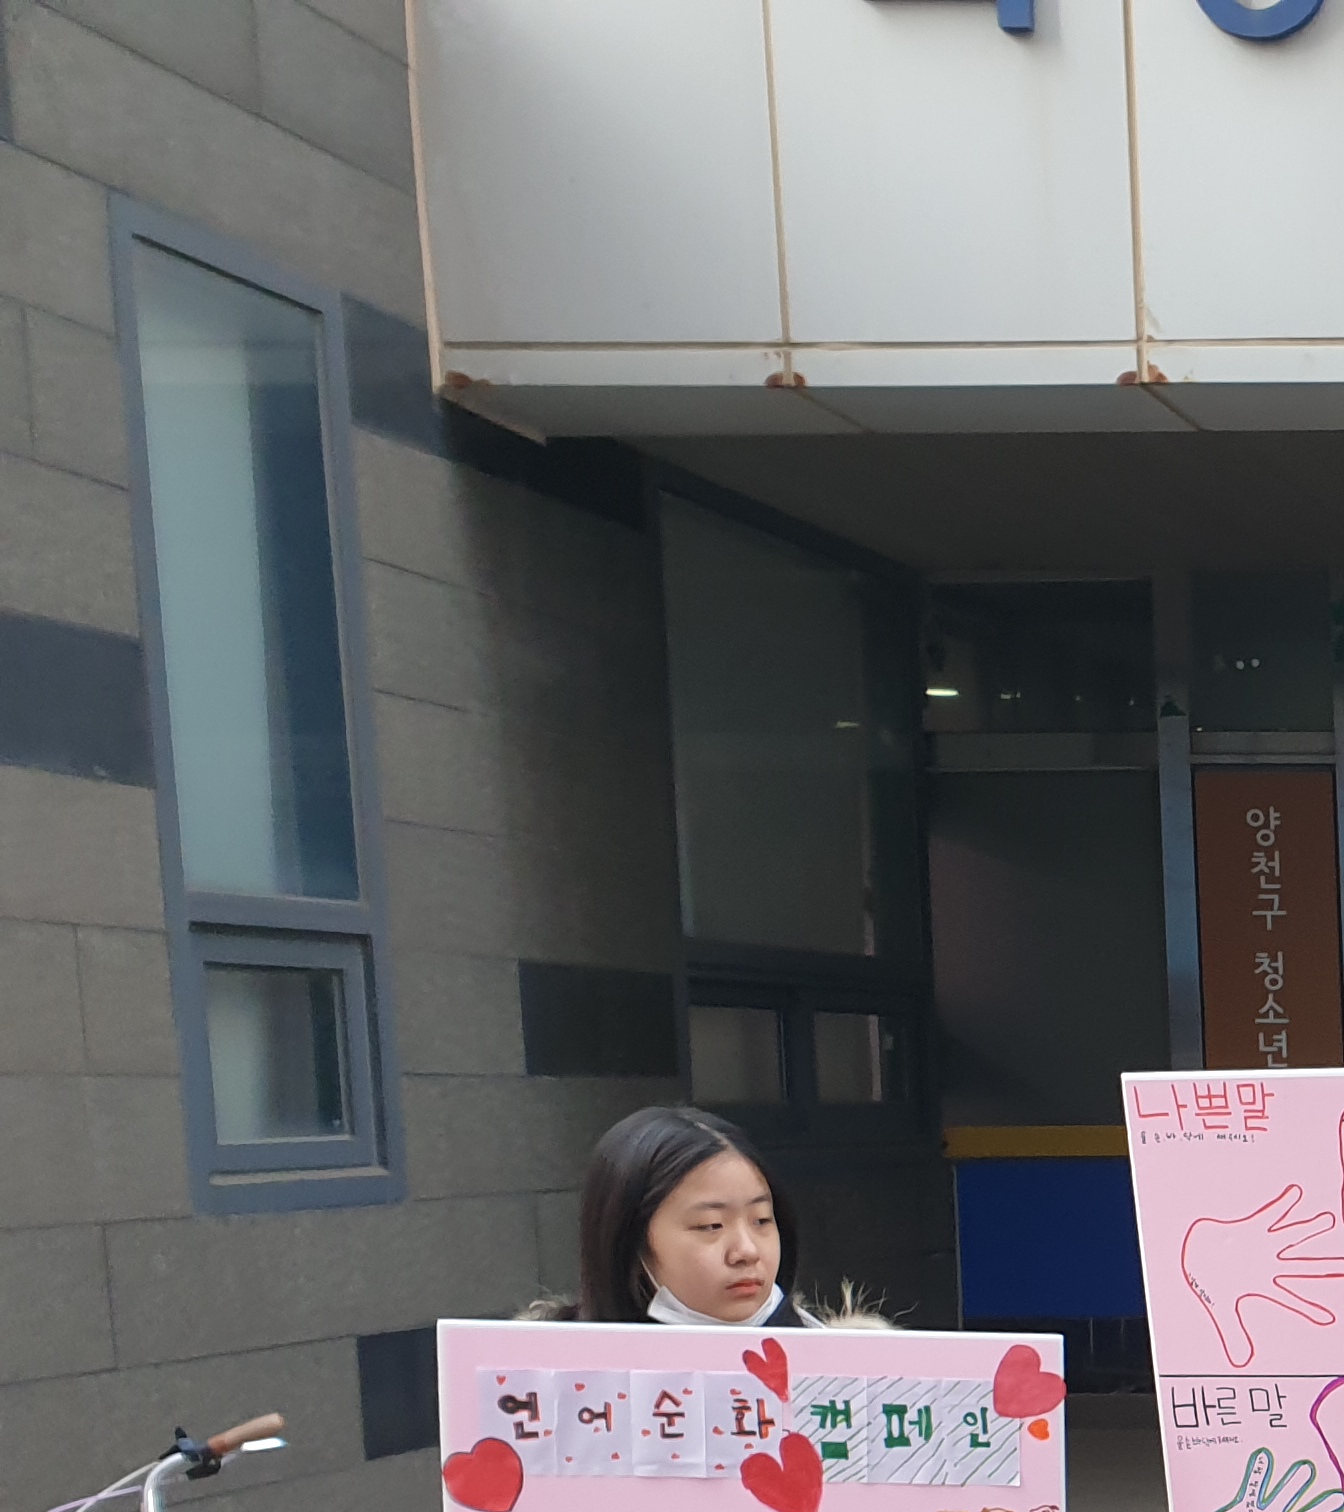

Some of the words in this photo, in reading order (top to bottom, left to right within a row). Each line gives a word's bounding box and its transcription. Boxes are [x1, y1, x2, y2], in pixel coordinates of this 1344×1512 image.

[1246, 805, 1287, 931] 양천구
[1254, 951, 1289, 1068] 청소년
[1133, 1080, 1275, 1134] 나쁜말
